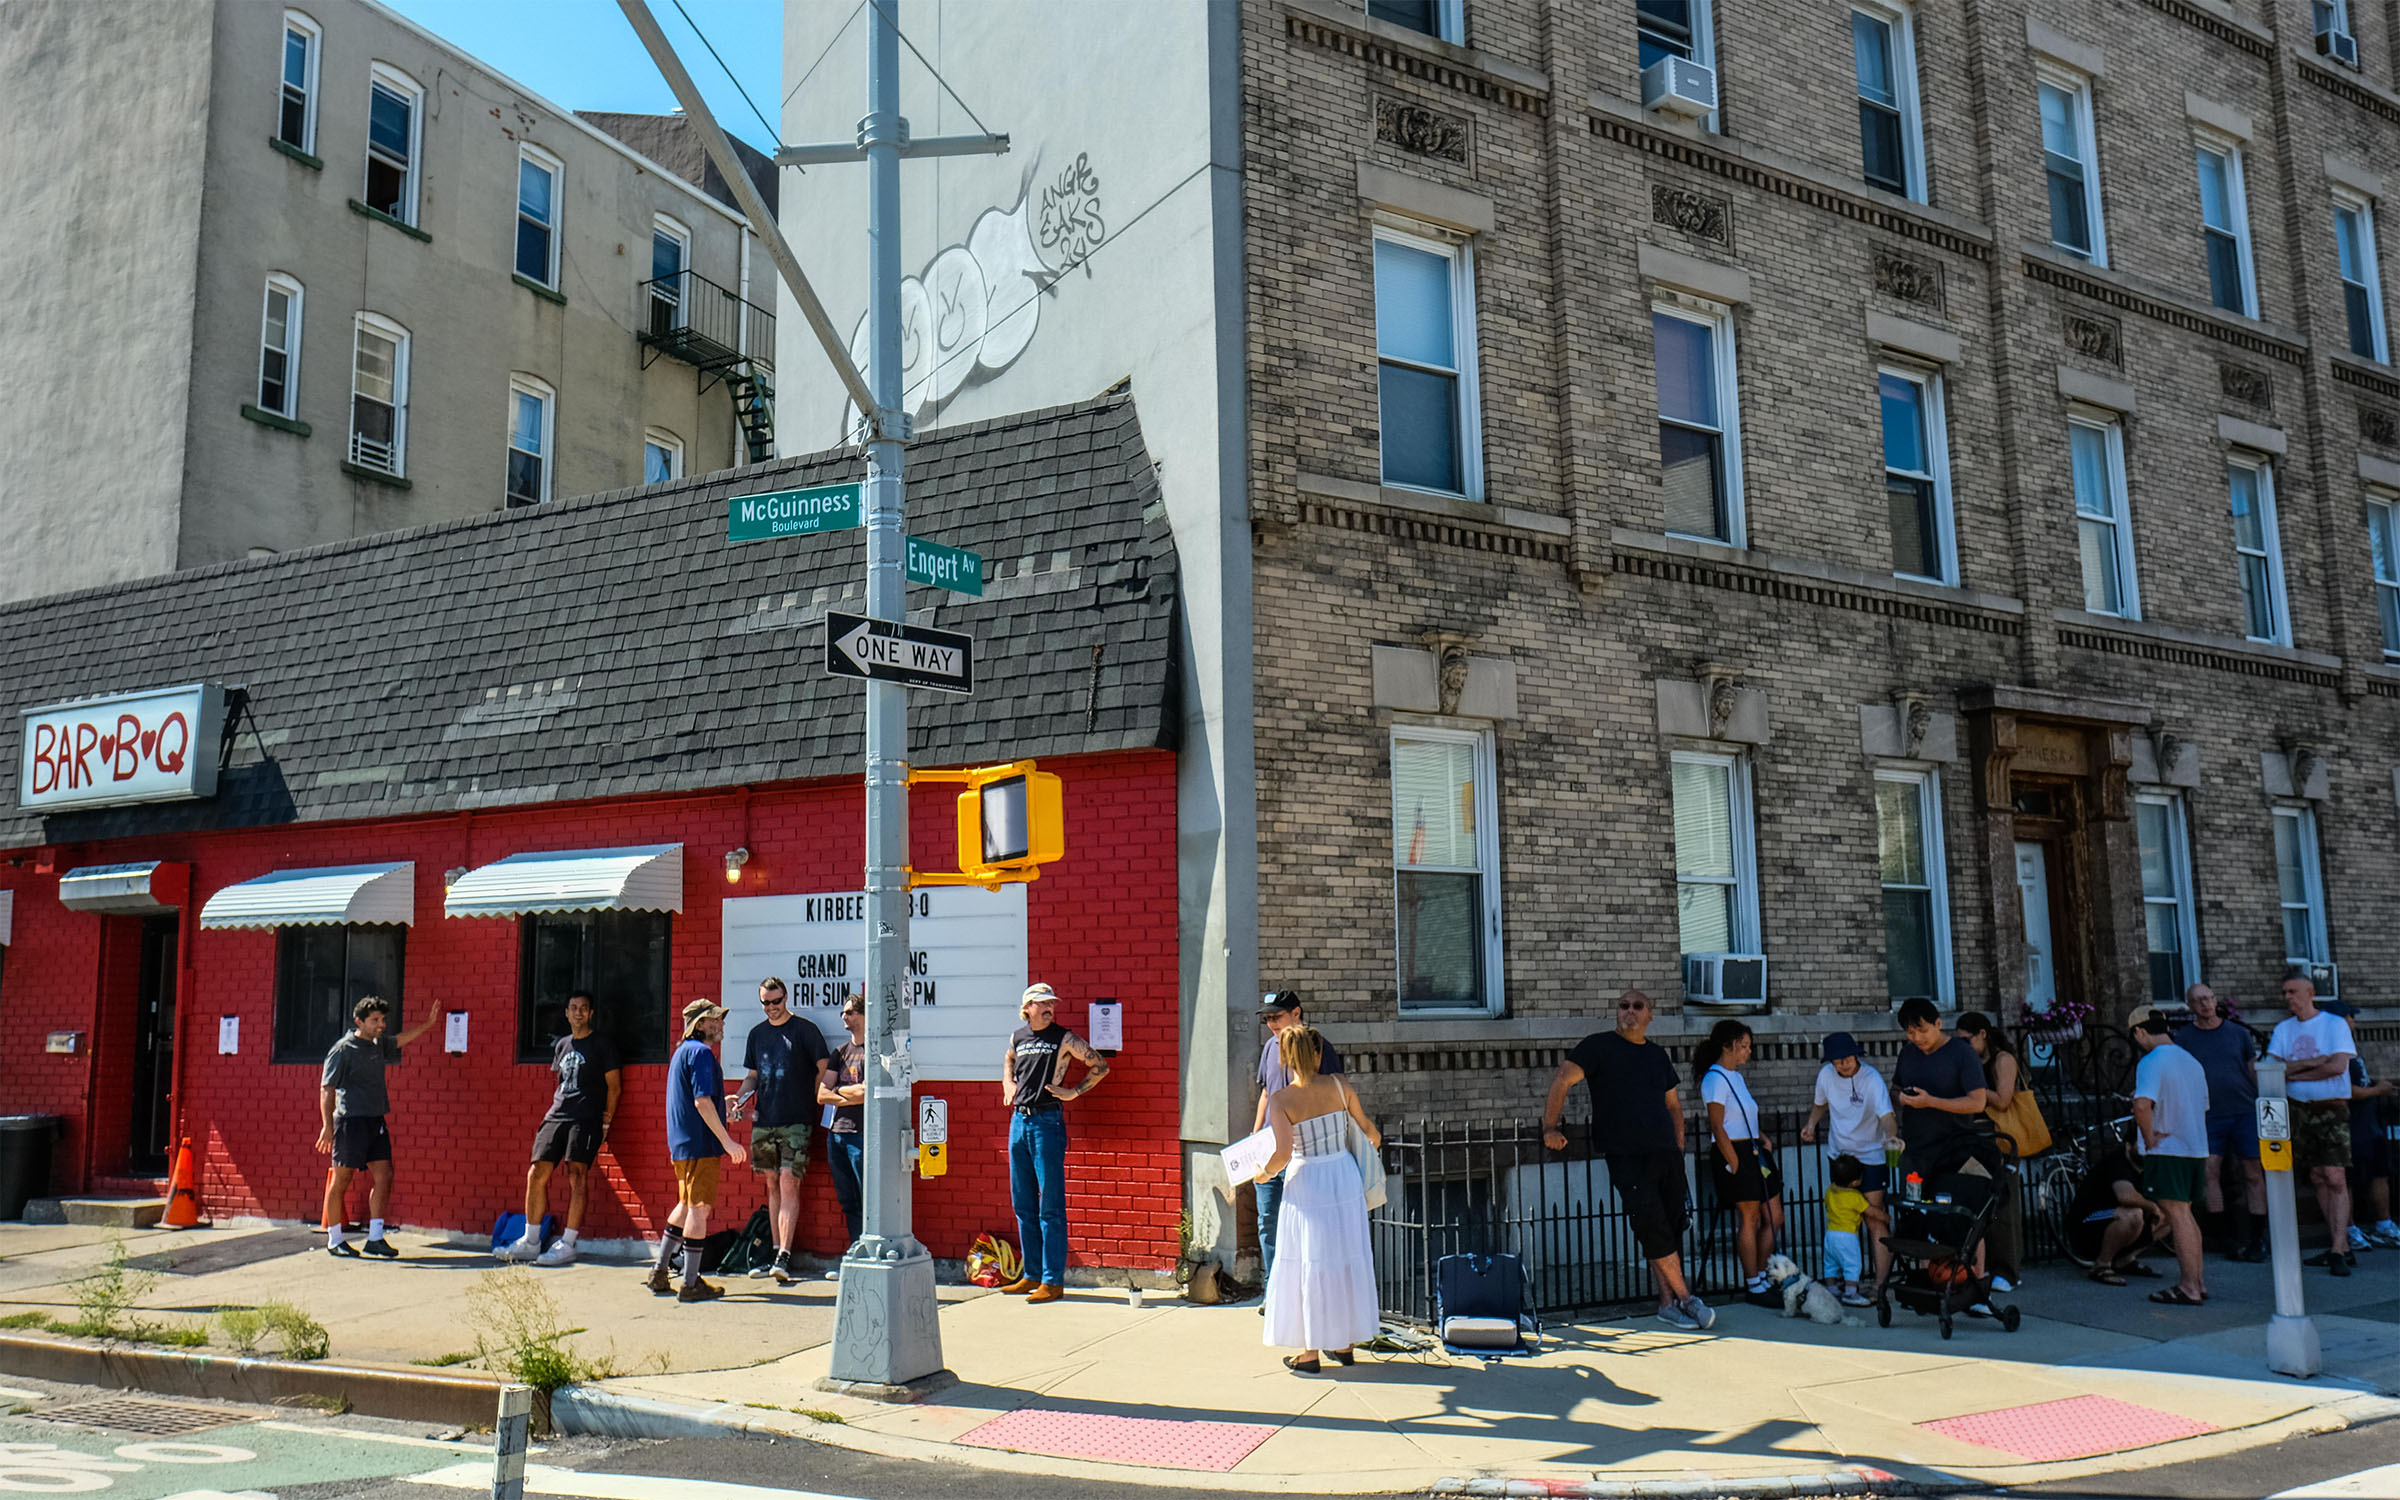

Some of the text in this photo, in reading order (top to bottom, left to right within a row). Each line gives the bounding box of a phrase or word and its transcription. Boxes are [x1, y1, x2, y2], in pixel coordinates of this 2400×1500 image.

[741, 493, 851, 522] McGuinness
[772, 516, 820, 534] Boulevard
[908, 541, 975, 585] Engert Av
[856, 635, 953, 672] ONE WAY
[798, 953, 847, 979] GRAND
